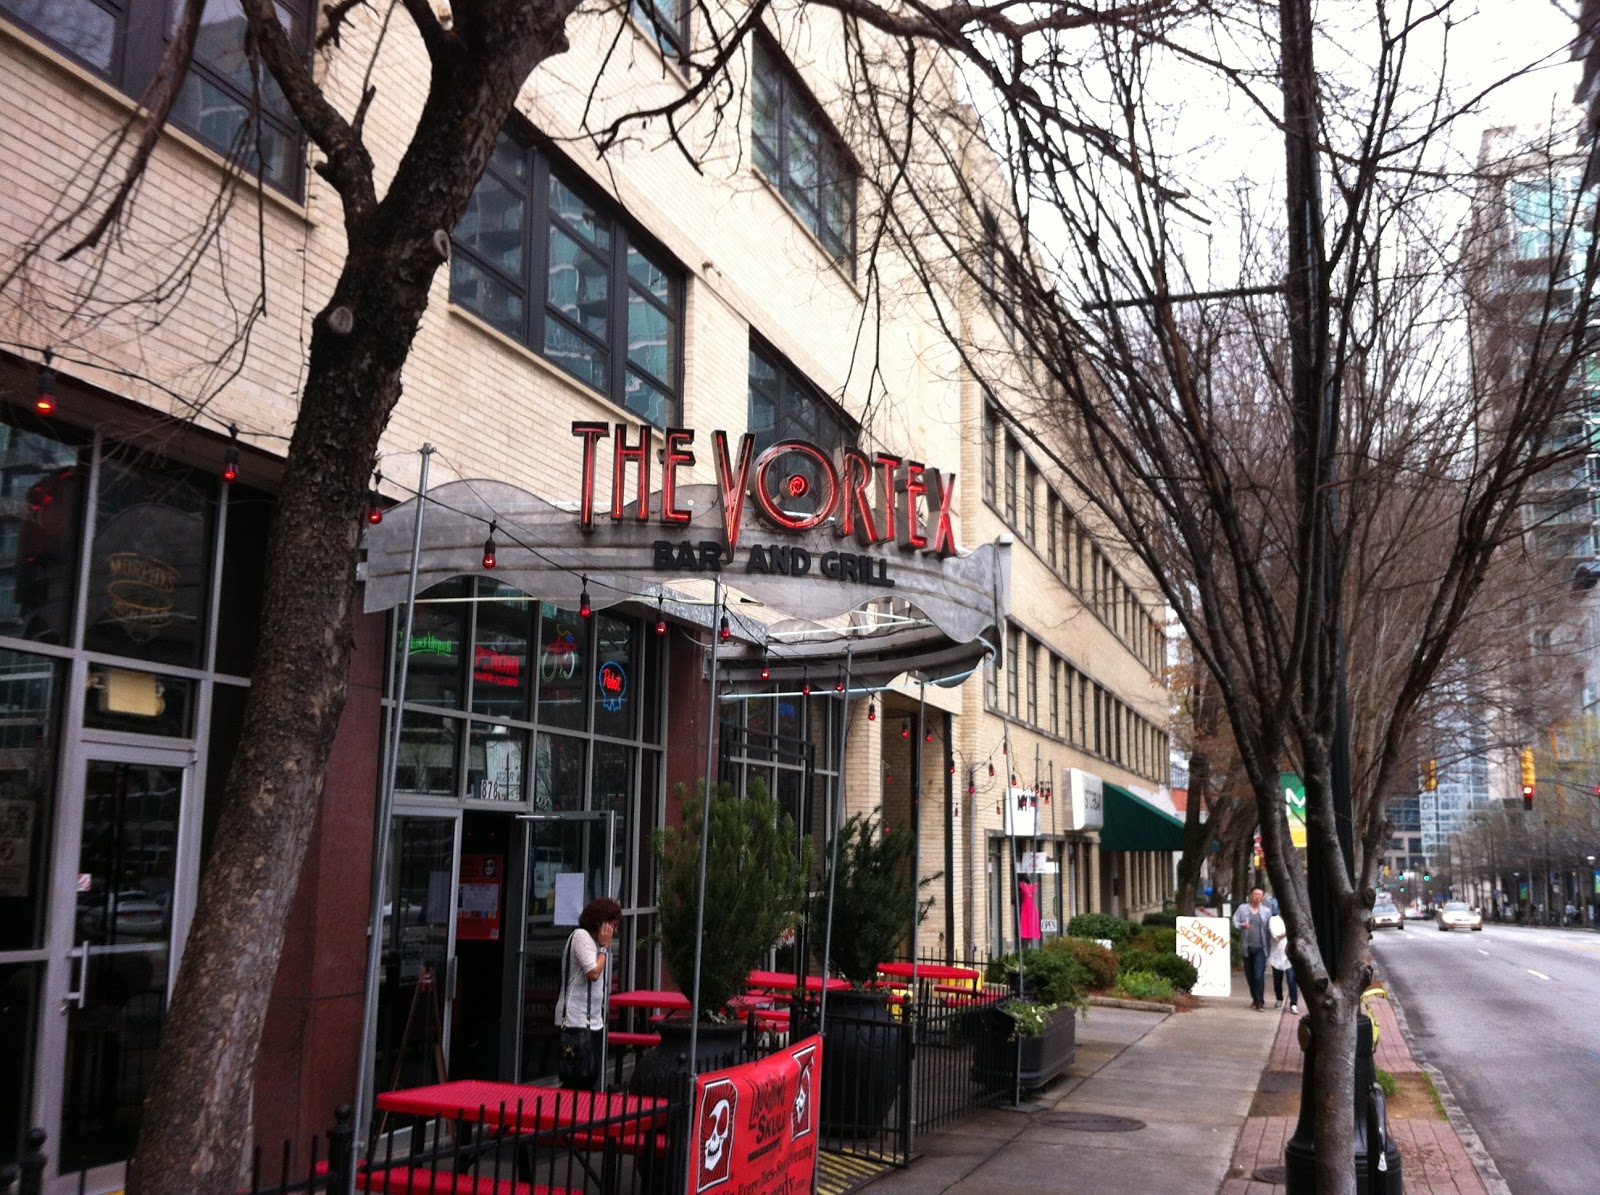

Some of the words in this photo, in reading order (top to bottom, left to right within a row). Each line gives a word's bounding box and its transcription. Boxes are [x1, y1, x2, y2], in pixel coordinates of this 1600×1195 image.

[572, 421, 696, 533] THE
[711, 429, 957, 564] VORTEX
[654, 540, 721, 572] BAR
[746, 544, 811, 577] AND
[821, 550, 895, 588] GRILL
[482, 780, 499, 799] 878
[1042, 920, 1057, 931] OPEN
[1177, 925, 1215, 956] SIZING
[1191, 919, 1229, 949] DOWN
